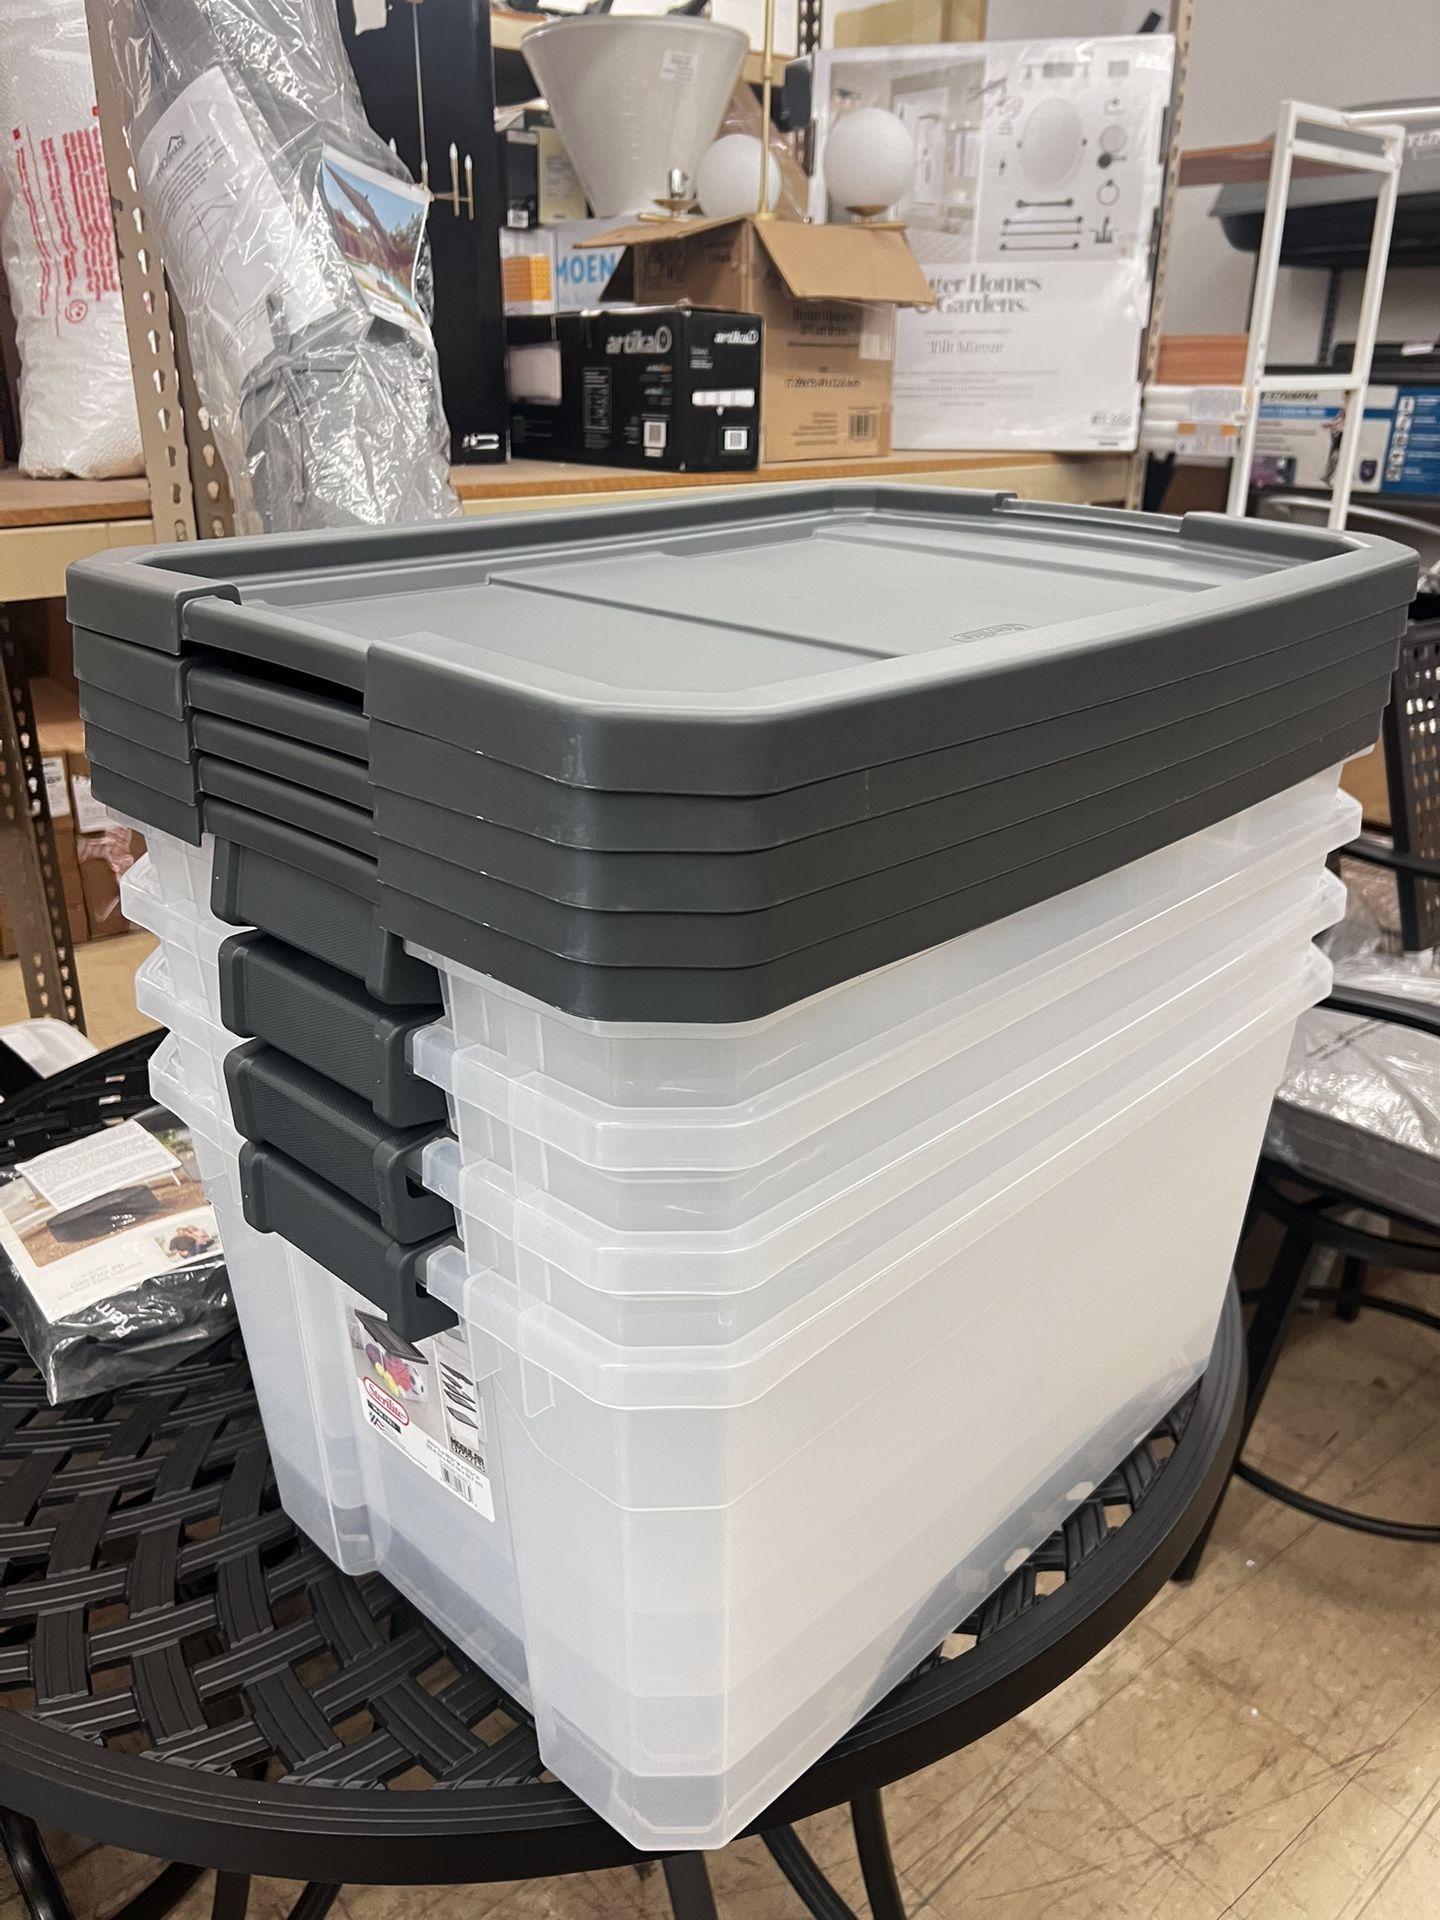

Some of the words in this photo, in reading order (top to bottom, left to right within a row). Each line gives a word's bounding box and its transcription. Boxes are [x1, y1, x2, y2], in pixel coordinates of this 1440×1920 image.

[556, 254, 617, 284] MOEN
[969, 273, 1042, 293] Homes
[605, 330, 660, 355] artika
[368, 1382, 406, 1420] Sterilite
